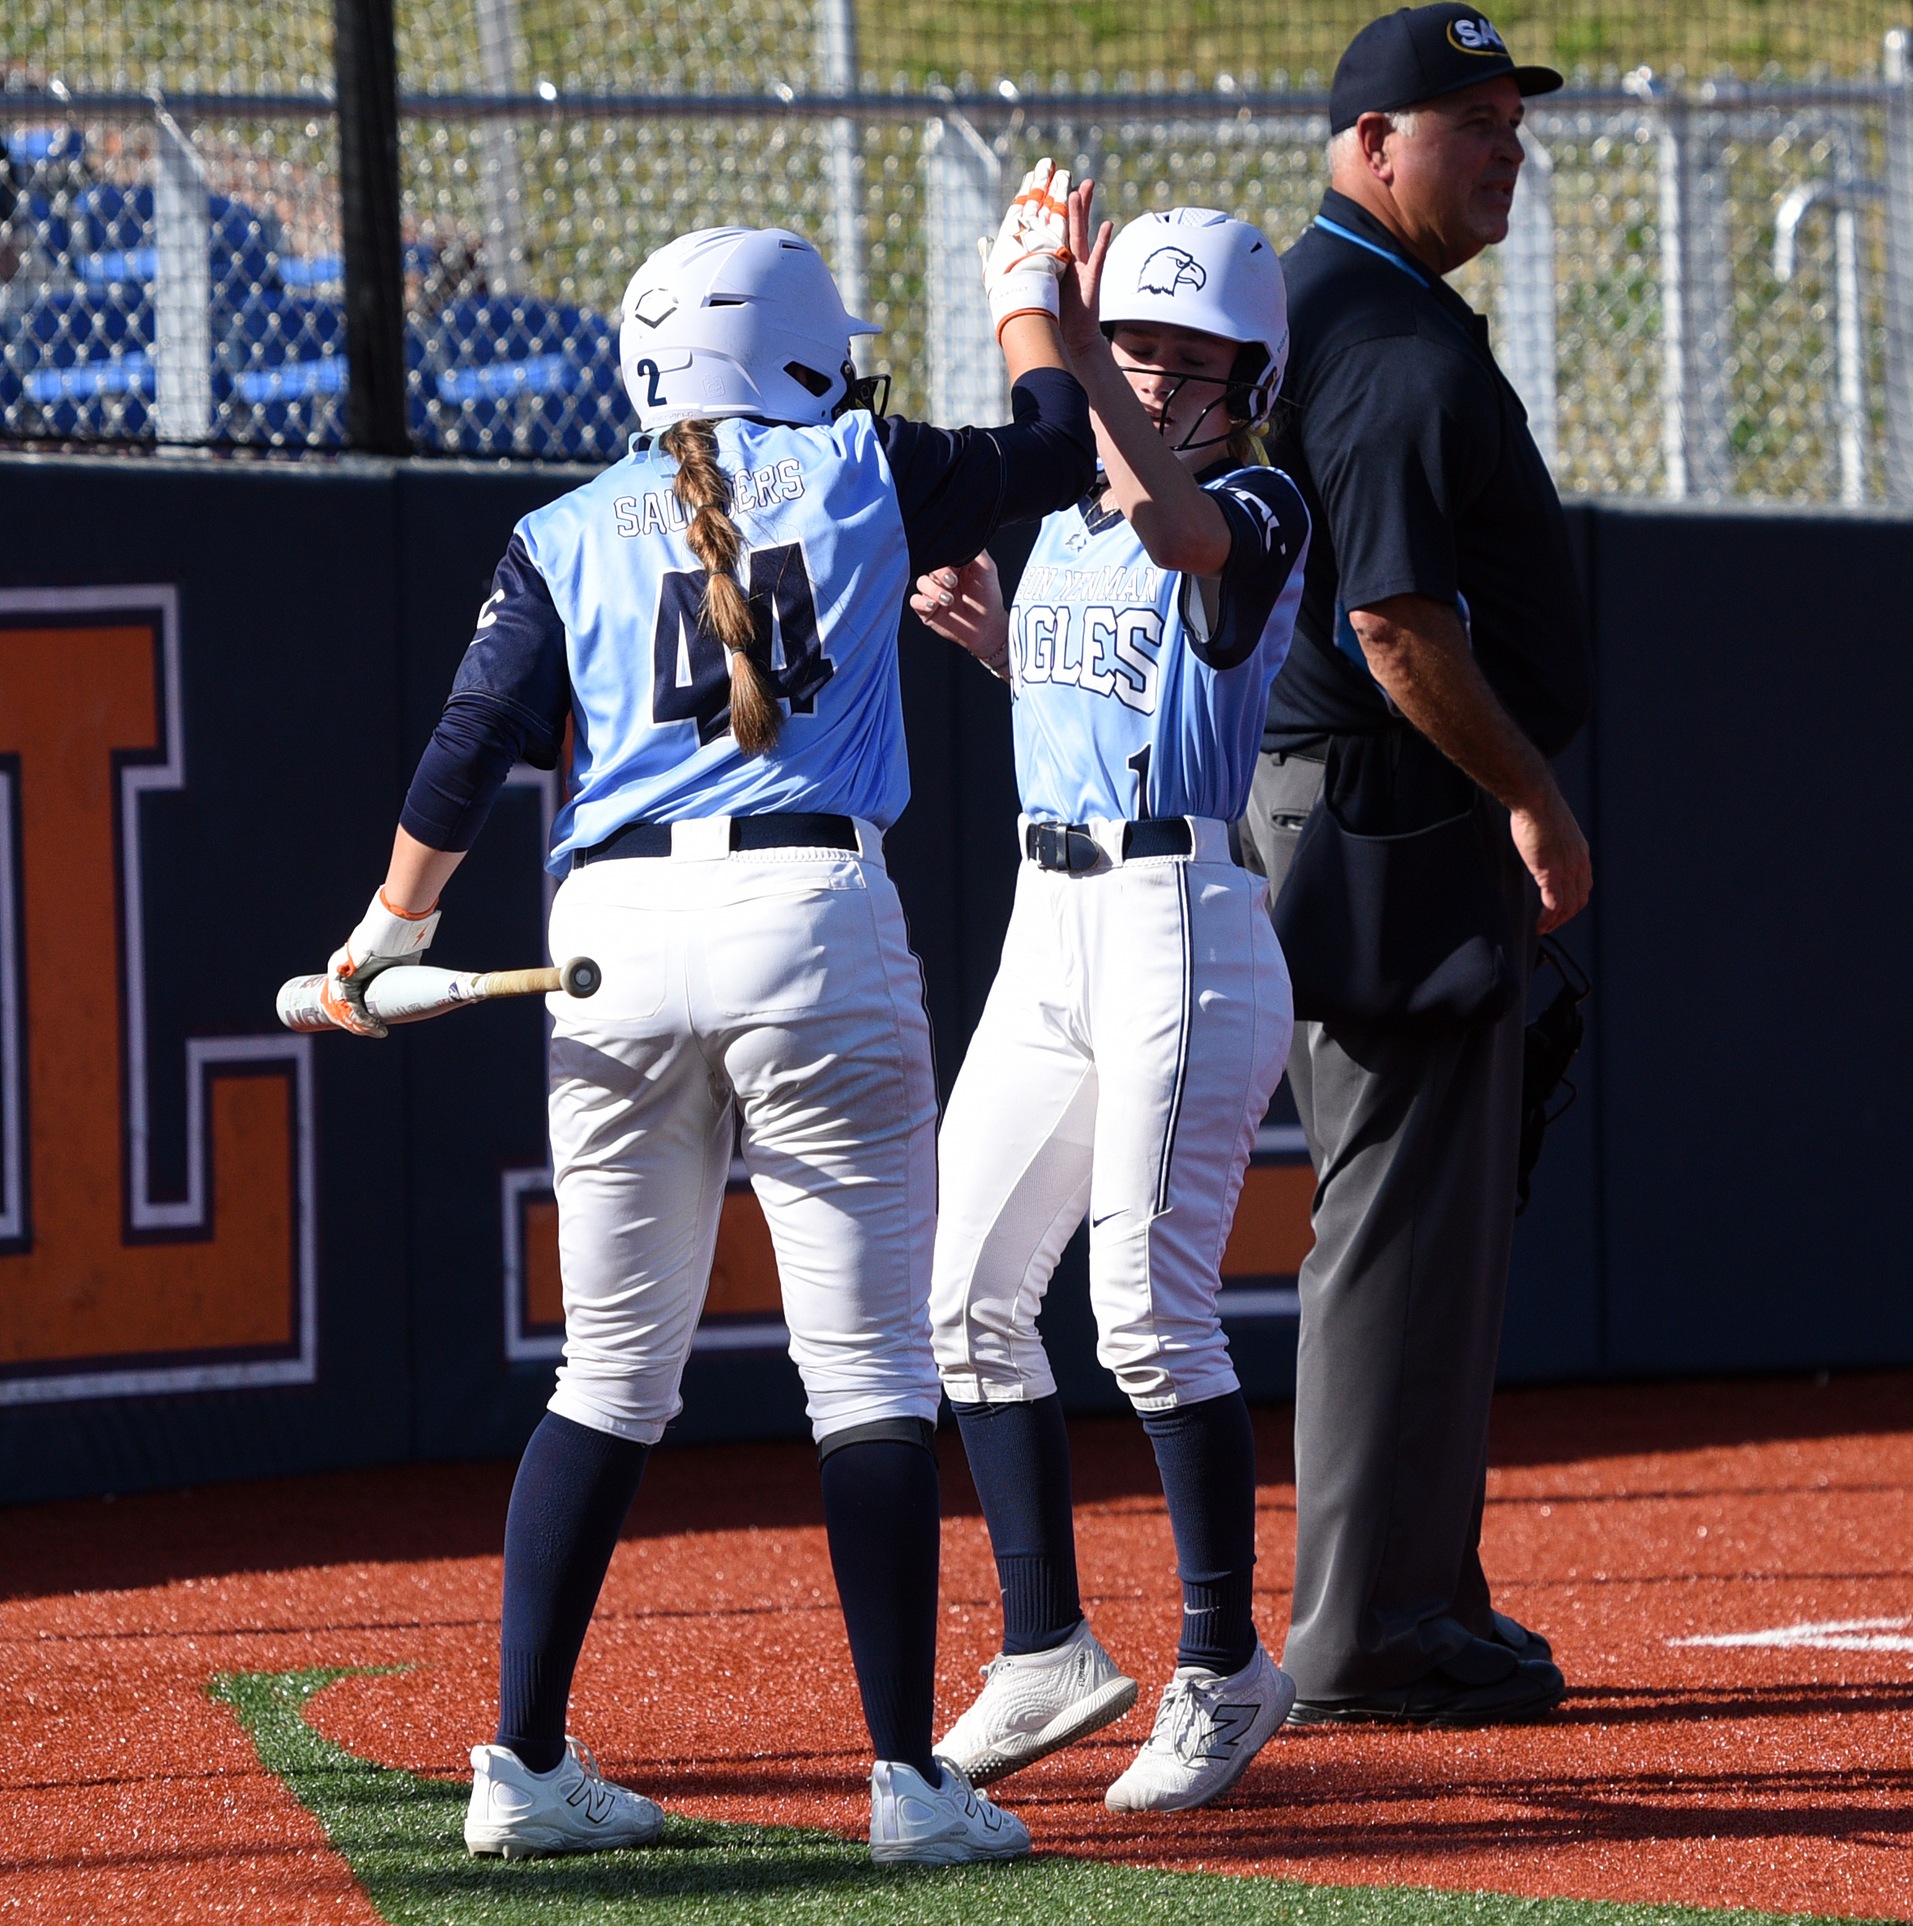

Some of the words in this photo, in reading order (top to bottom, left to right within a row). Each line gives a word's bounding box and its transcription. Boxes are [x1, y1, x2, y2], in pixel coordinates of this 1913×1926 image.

[636, 358, 668, 408] 2
[613, 457, 806, 538] SAUERS
[650, 537, 838, 748] 44
